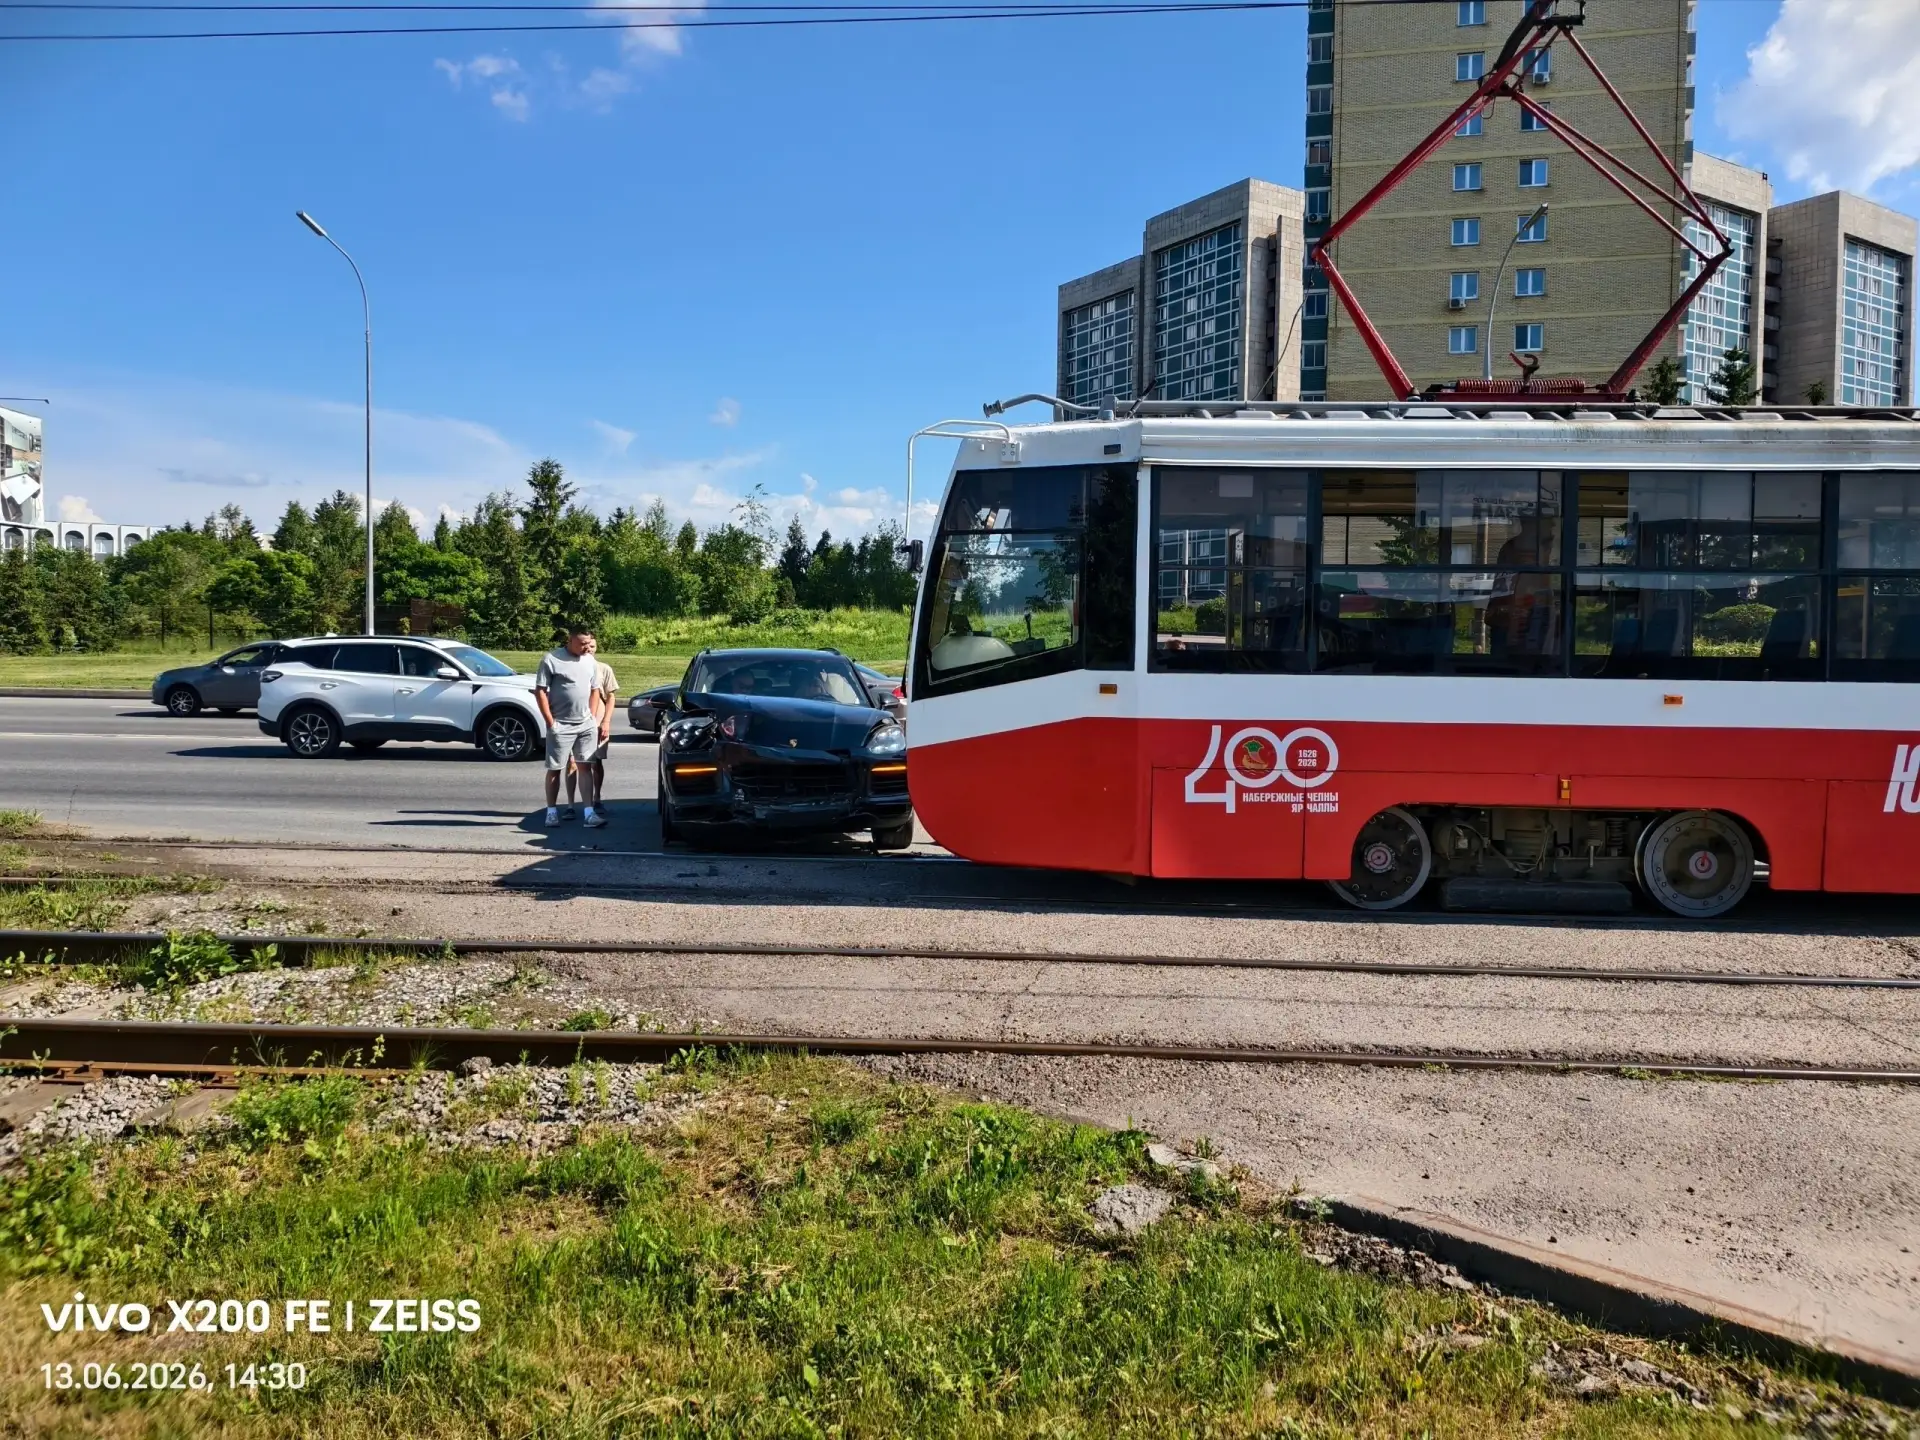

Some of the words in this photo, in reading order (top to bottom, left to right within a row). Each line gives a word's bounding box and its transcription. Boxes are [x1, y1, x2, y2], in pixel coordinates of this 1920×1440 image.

[1298, 749, 1317, 758] 1626
[1298, 758, 1317, 767] 2026
[1185, 725, 1338, 813] 400
[1242, 792, 1304, 802] НАБЕРЕЖНЫЕ
[1307, 792, 1339, 802] ЧЕЛНЫ
[1291, 803, 1304, 813] ЯР
[1306, 803, 1339, 813] ЧАЛЛЫ
